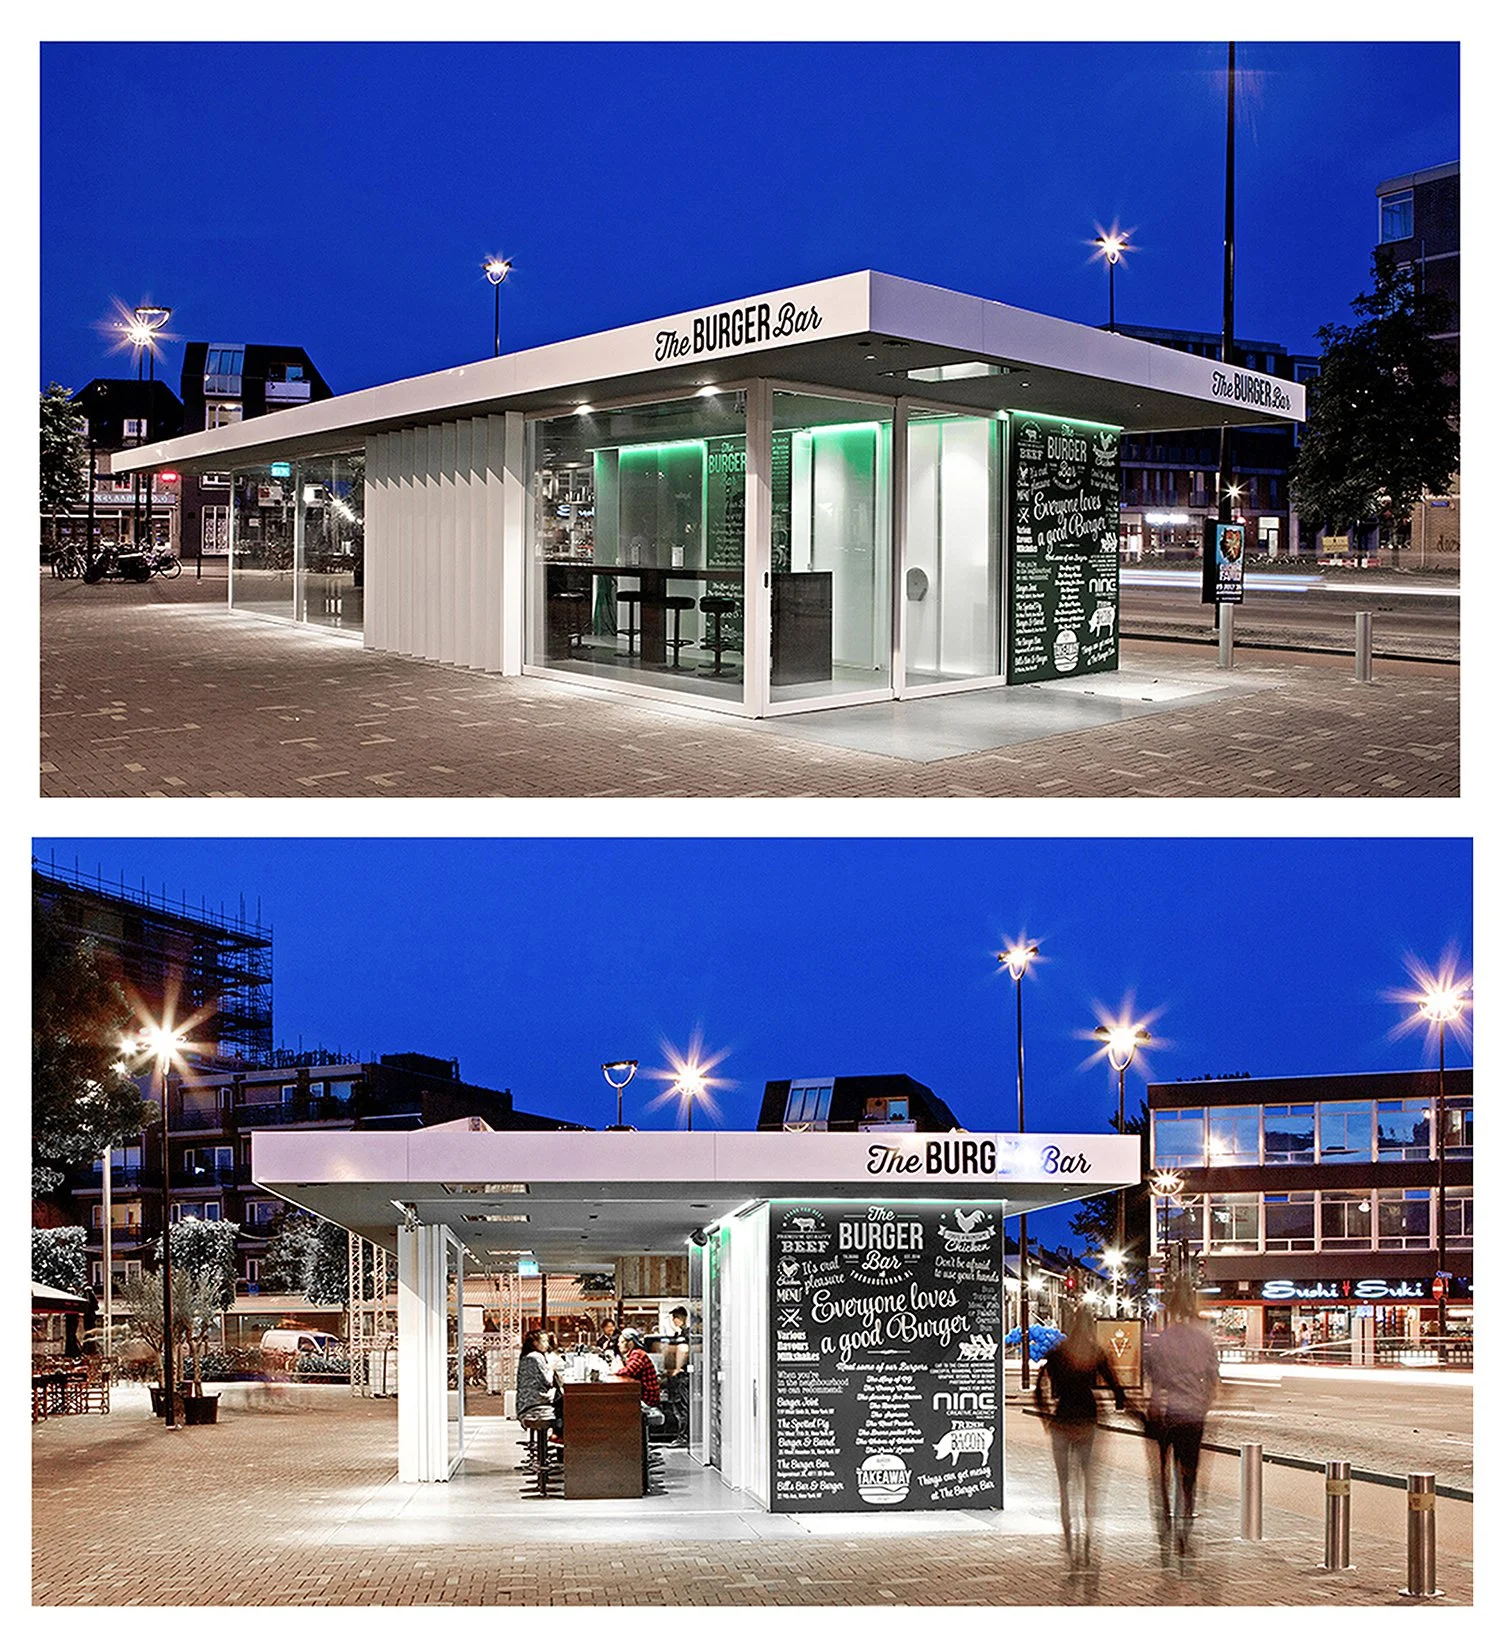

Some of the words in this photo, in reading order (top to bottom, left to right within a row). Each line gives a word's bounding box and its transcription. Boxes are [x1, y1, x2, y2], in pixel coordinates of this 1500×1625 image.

[655, 330, 692, 362] The
[693, 303, 771, 354] BURGER
[772, 302, 823, 338] Bar
[1212, 370, 1234, 398] The
[1234, 372, 1272, 408] BURGER
[1272, 386, 1291, 411] Bar
[1047, 436, 1087, 462] BURGER
[708, 452, 746, 474] BURGER
[1058, 460, 1077, 477] Bar
[1033, 492, 1080, 525] Everyone
[1079, 489, 1102, 511] loves
[1037, 532, 1045, 547] a
[1046, 518, 1068, 555] good
[1068, 512, 1107, 542] Burger
[867, 1144, 925, 1174] The
[926, 1140, 1020, 1174] BURG
[1042, 1145, 1092, 1174] Bar
[868, 1206, 896, 1222] The
[839, 1222, 924, 1250] BURGER
[781, 1241, 829, 1253] BEEF
[945, 1239, 992, 1252] Chicken
[861, 1250, 902, 1270] Bar
[1262, 1280, 1339, 1299] Sushi
[1354, 1280, 1425, 1298] Suki
[811, 1289, 908, 1328] Everyone
[911, 1282, 960, 1311] loves
[777, 1330, 806, 1340] Various
[821, 1336, 836, 1354] a
[839, 1318, 885, 1363] good
[886, 1312, 971, 1348] Burger
[777, 1352, 820, 1362] Milkshakes
[777, 1397, 801, 1410] Burger
[777, 1418, 790, 1428] The
[791, 1418, 816, 1432] Spotted
[817, 1418, 829, 1432] Pig
[778, 1437, 802, 1450] Burger
[951, 1432, 985, 1450] BACON
[777, 1459, 790, 1469] The
[791, 1459, 815, 1471] Burger
[816, 1459, 830, 1469] Bar
[857, 1470, 912, 1484] TAKEAWAY
[917, 1474, 943, 1488] Things
[795, 1480, 810, 1491] Bar
[820, 1480, 845, 1494] Burger
[939, 1486, 954, 1498] The
[954, 1484, 980, 1498] Burger
[980, 1479, 995, 1490] Bar
